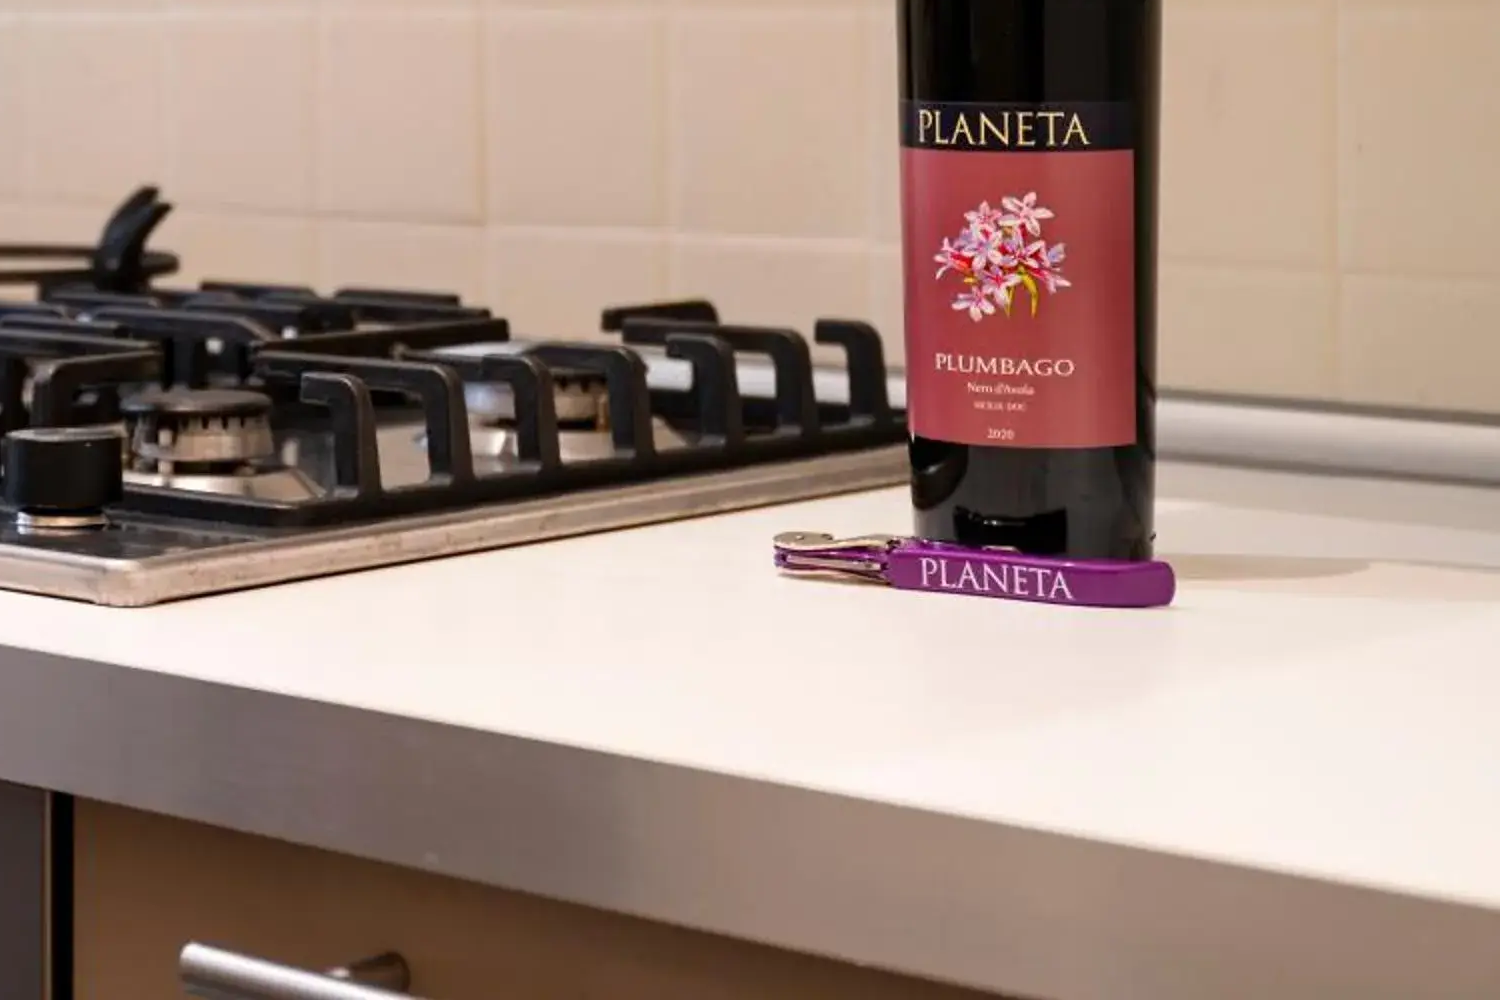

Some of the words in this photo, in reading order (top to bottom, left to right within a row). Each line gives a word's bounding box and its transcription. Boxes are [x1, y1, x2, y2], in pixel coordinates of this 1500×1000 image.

[918, 109, 1091, 146] PLANETA
[935, 353, 1075, 377] PLUMBAGO
[919, 557, 1074, 600] PLANETA
